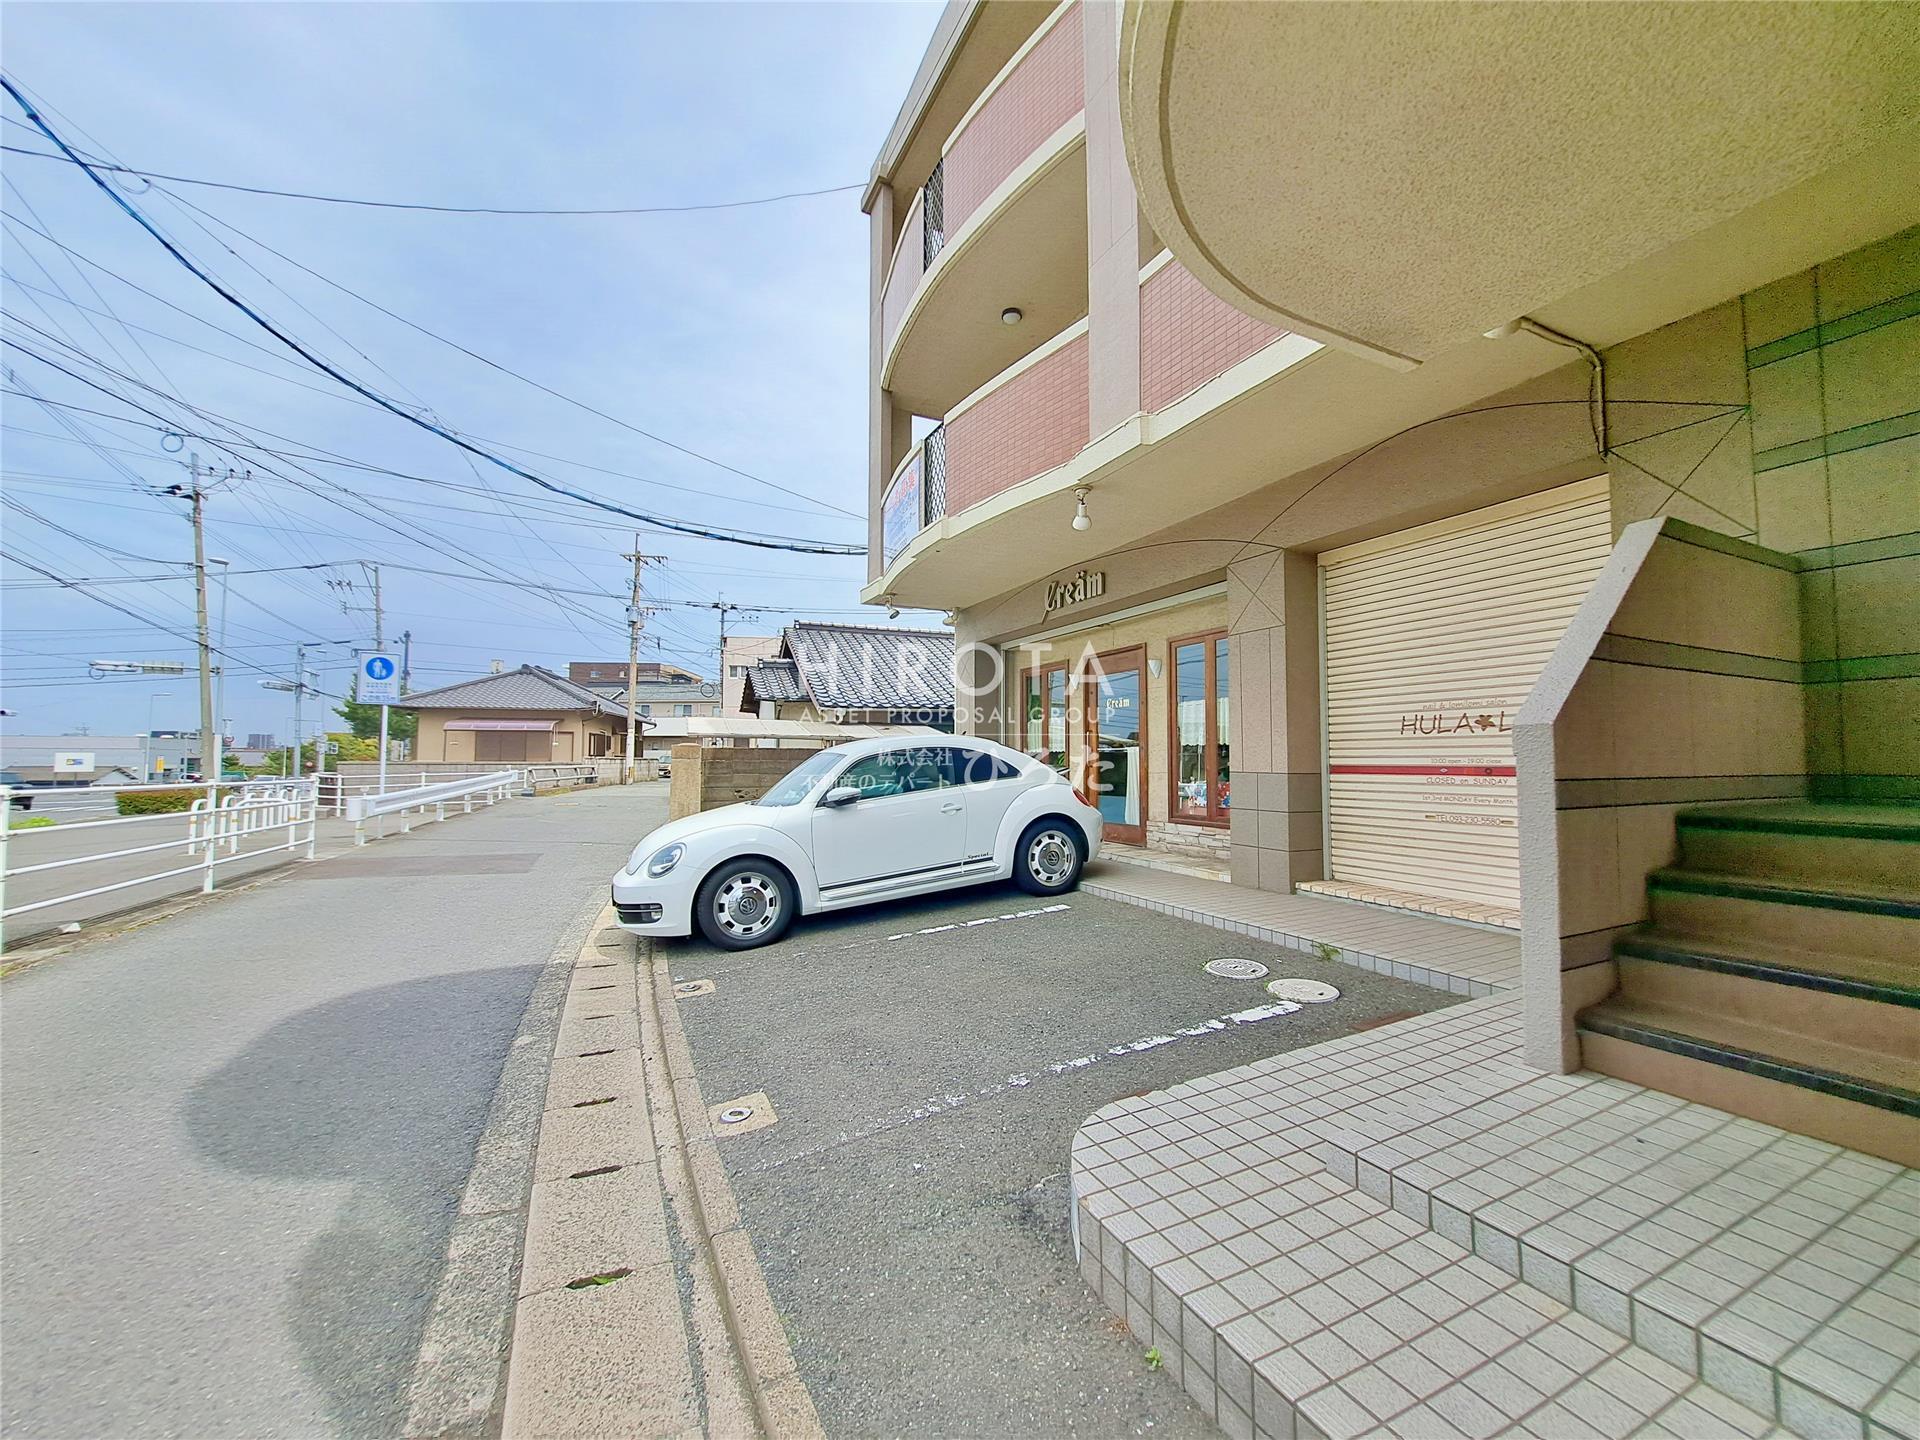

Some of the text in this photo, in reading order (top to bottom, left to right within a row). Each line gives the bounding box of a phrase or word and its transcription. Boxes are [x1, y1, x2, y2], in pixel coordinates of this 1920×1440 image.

[1400, 713, 1475, 735] HULA
[1426, 777, 1456, 785] CLOSED
[1473, 777, 1509, 786] SUNDAY
